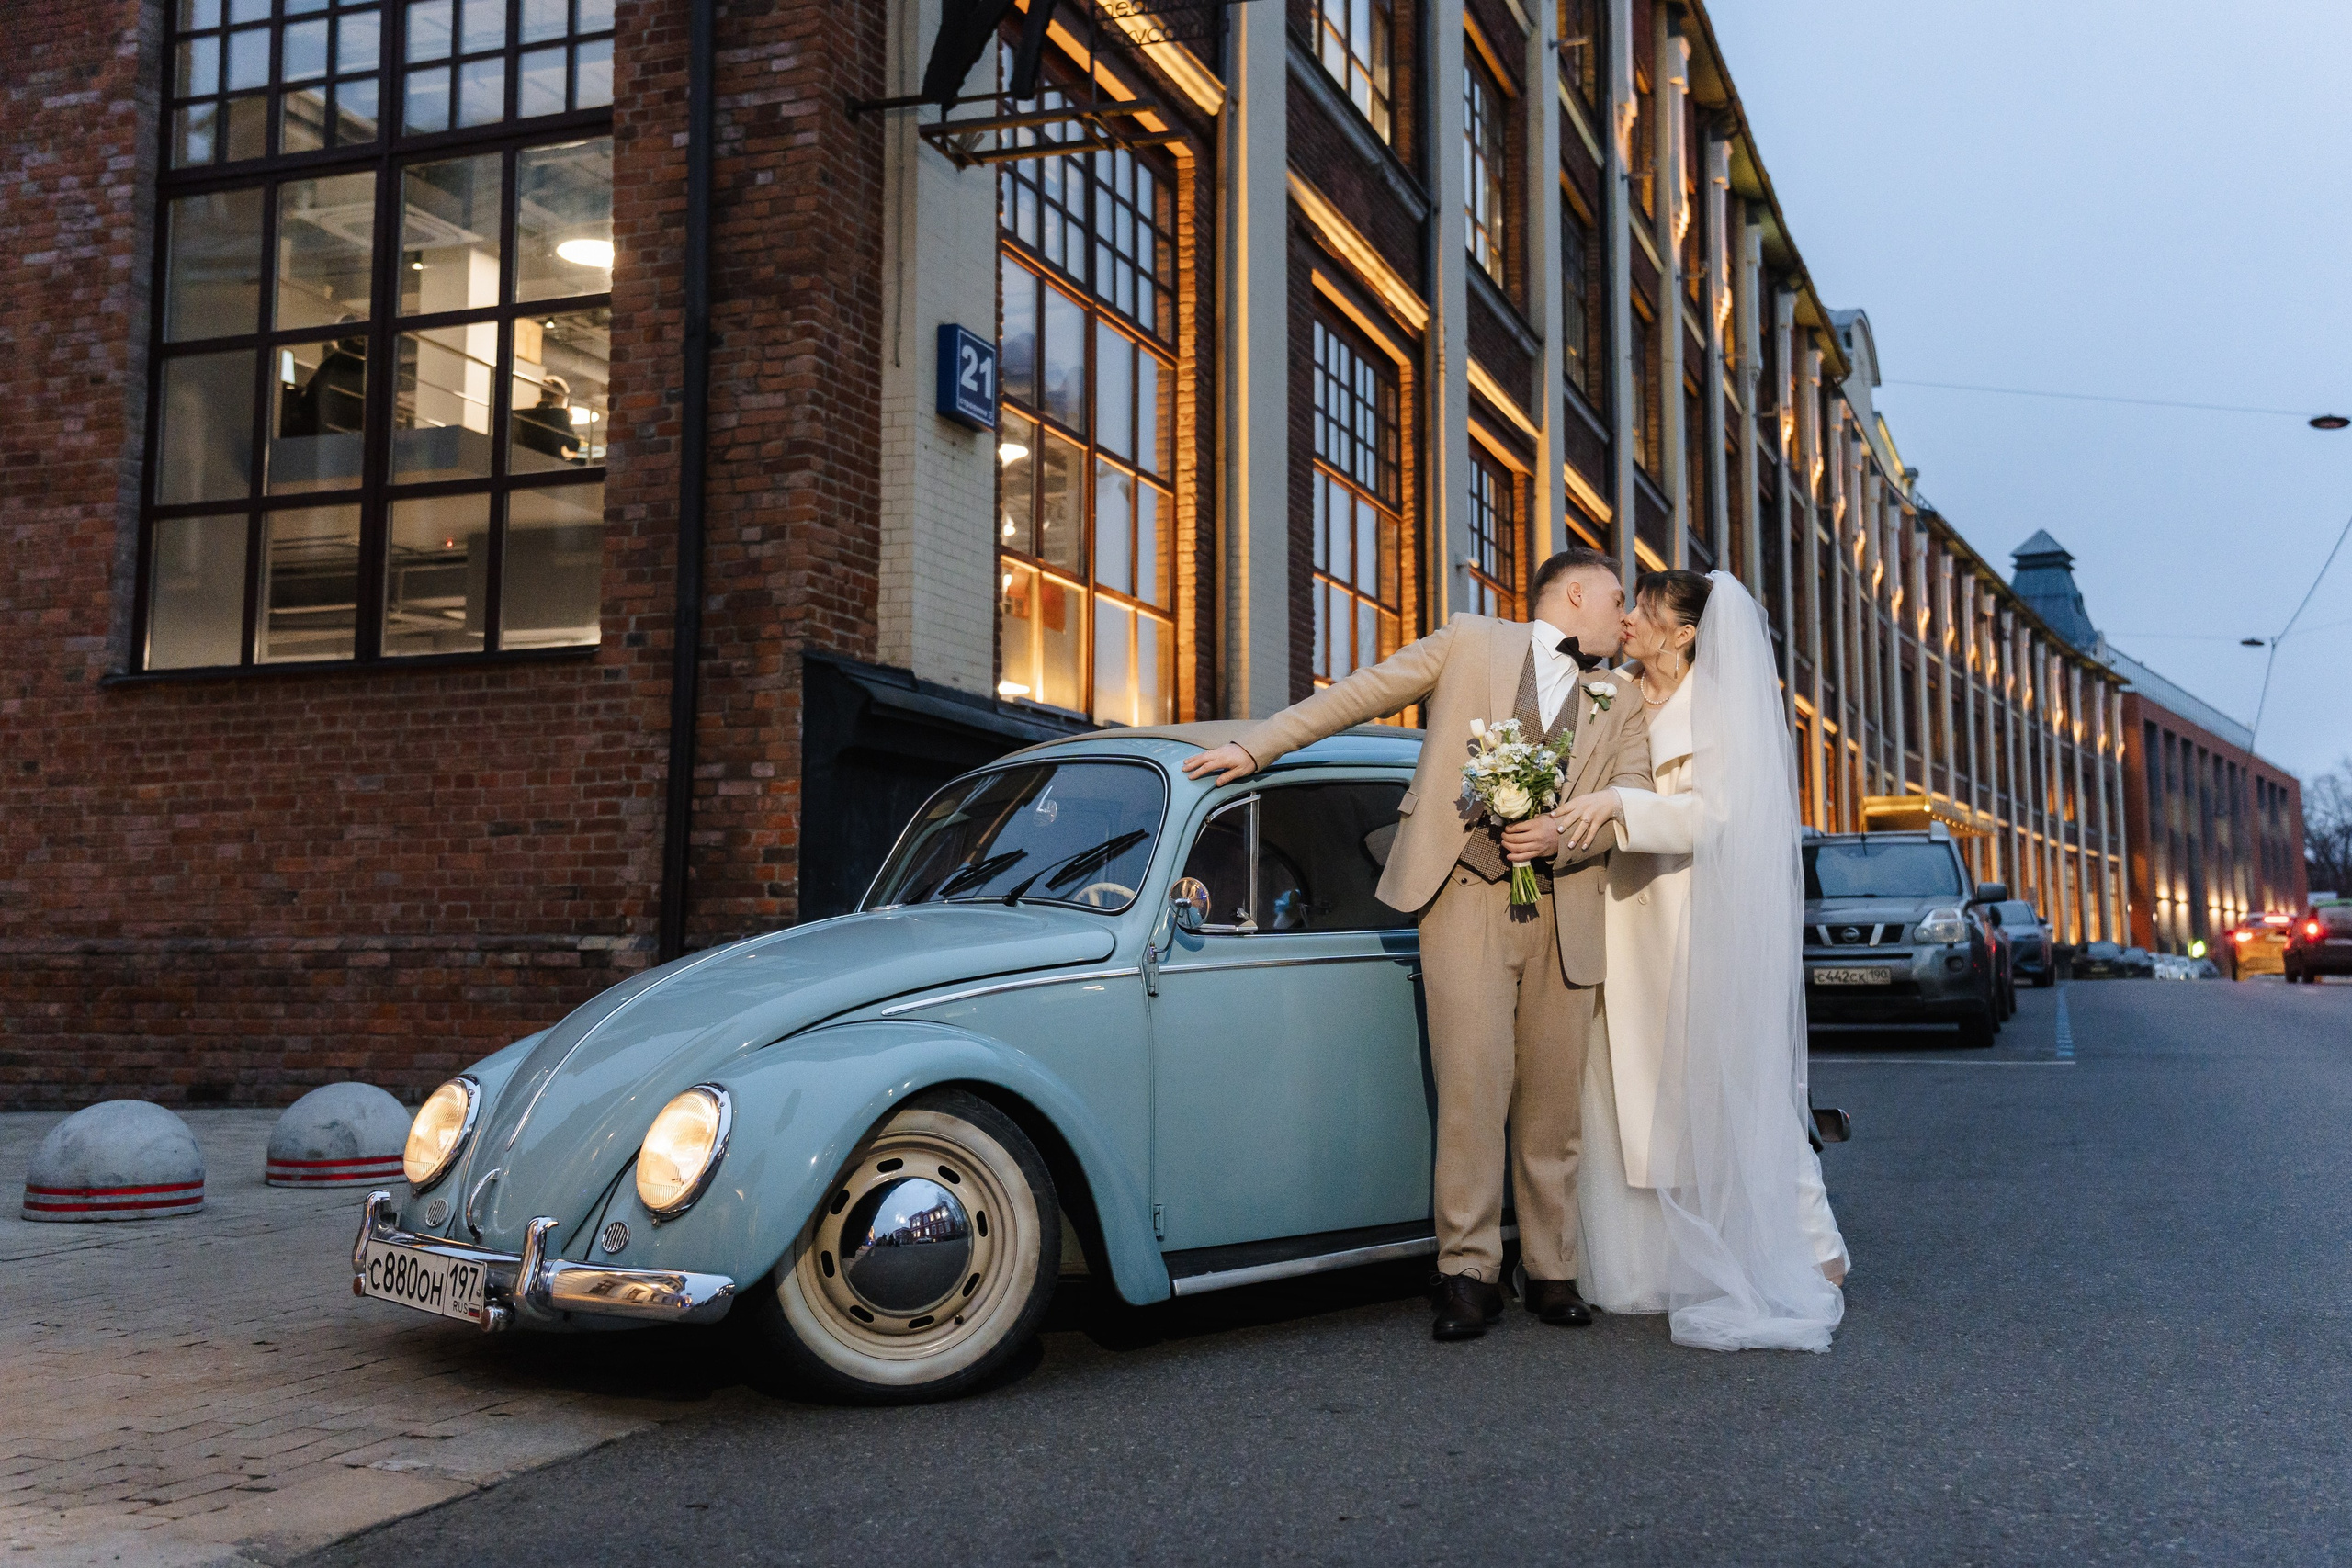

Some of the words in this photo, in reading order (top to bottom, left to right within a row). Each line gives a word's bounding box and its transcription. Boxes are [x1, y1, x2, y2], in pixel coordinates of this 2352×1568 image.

[960, 344, 992, 400] 21
[449, 1262, 479, 1301] 197
[452, 1300, 469, 1314] RUS
